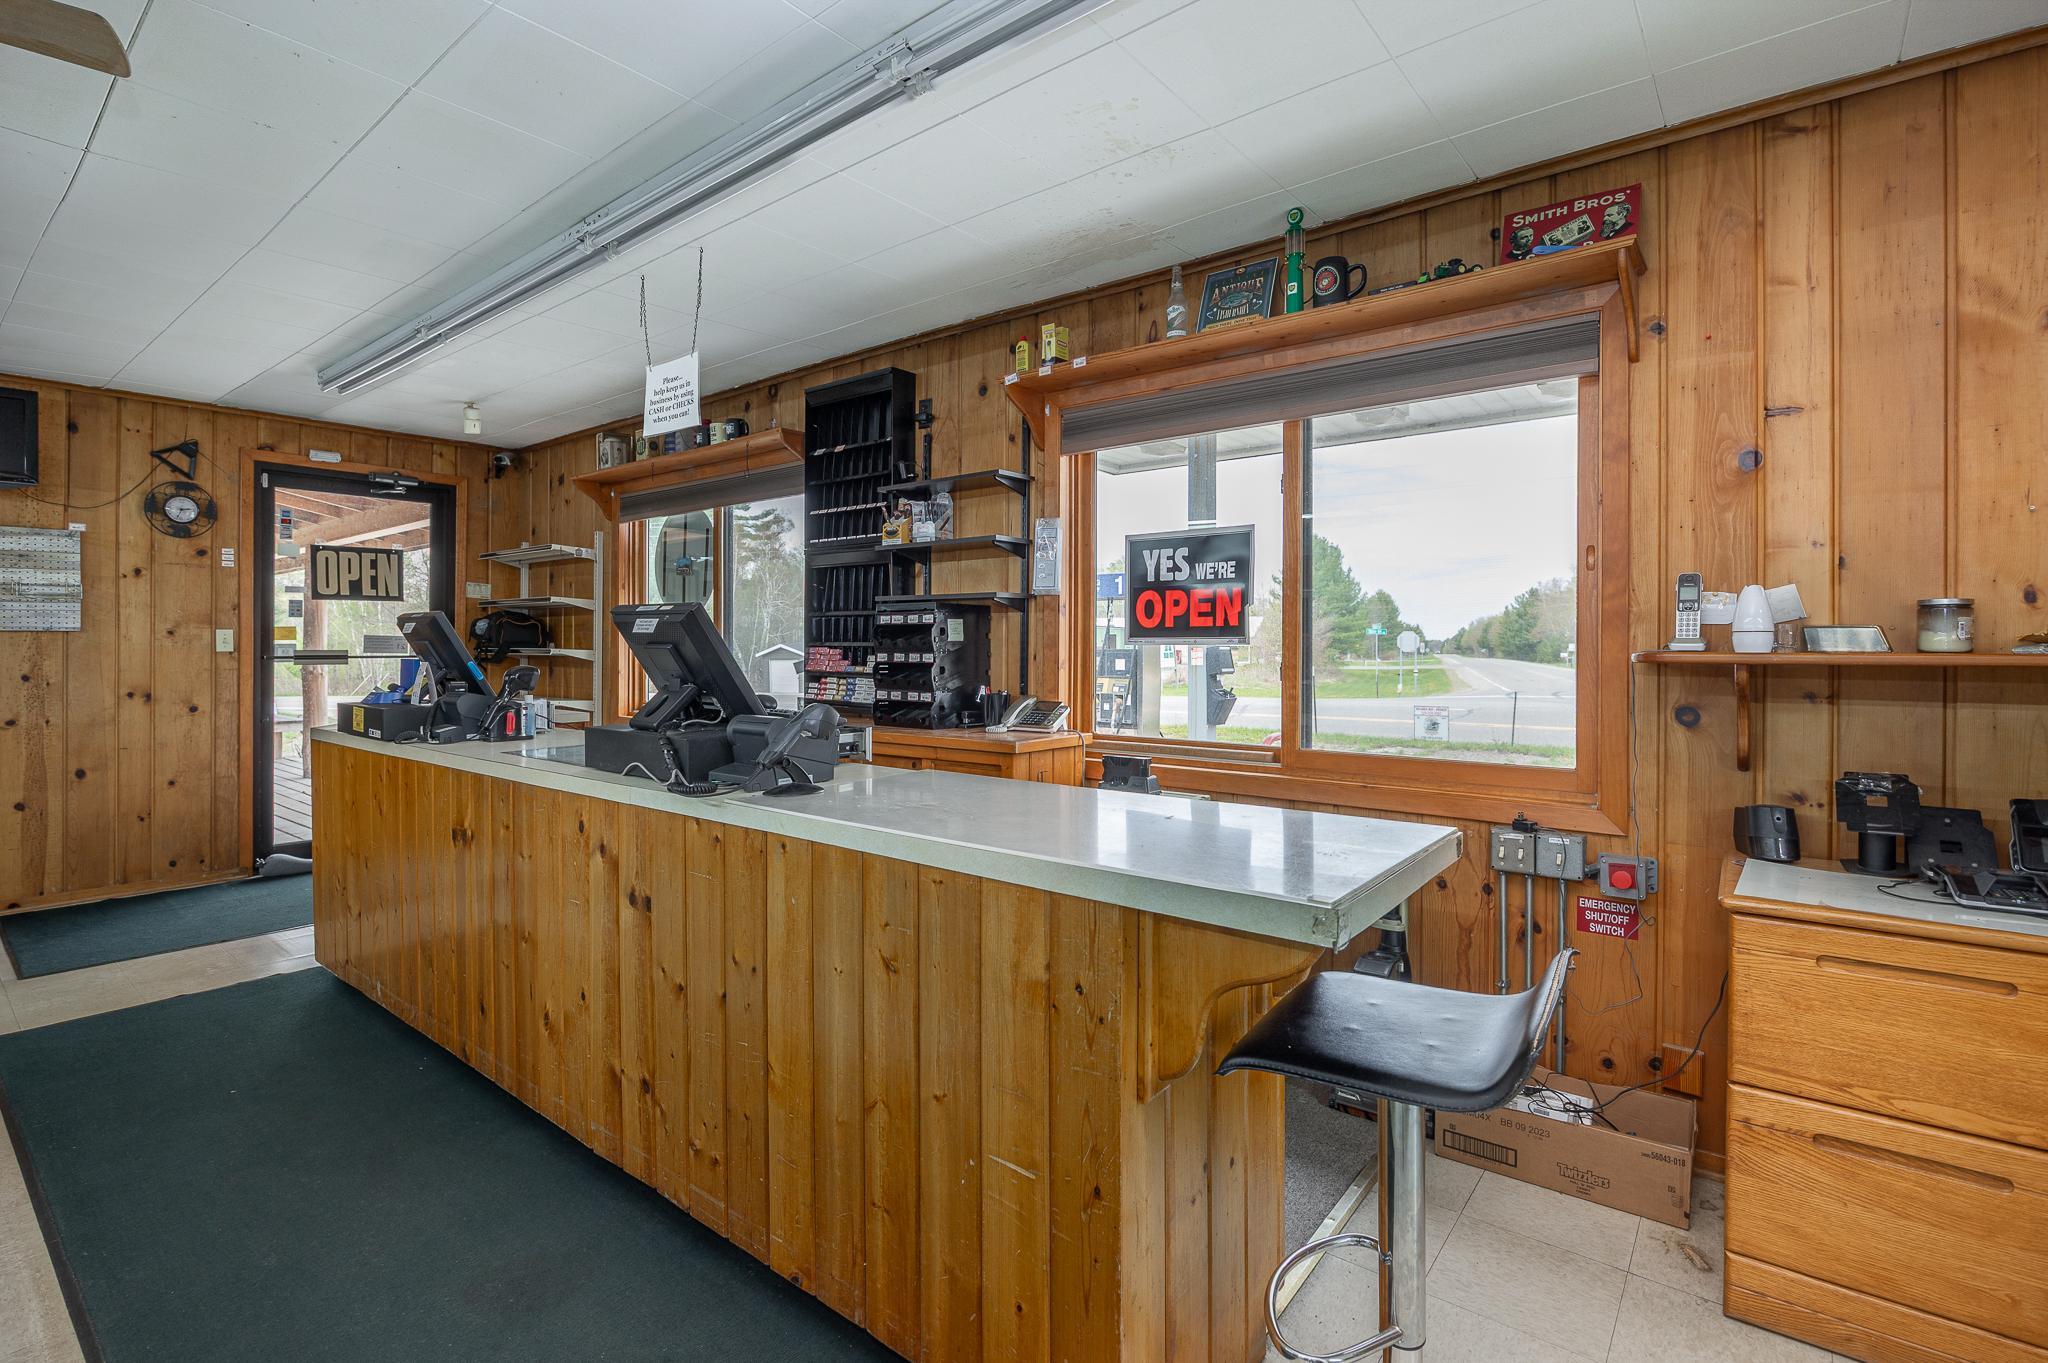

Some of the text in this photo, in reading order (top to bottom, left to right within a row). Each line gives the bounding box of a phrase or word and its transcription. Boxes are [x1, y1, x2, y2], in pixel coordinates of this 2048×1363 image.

[1512, 206, 1568, 228] SMITH
[1211, 277, 1264, 305] ANTIQUE
[653, 387, 665, 396] help
[666, 384, 678, 394] keep
[685, 380, 691, 388] in
[648, 406, 664, 416] CASH
[672, 398, 695, 410] CHECKS
[649, 389, 694, 407] business by using
[652, 408, 690, 424] when you can!
[316, 550, 399, 597] OPEN
[1142, 547, 1236, 582] YES WE'RE
[1135, 587, 1242, 629] OPEN
[1579, 897, 1636, 914] EMERGENCY
[1585, 911, 1630, 926] SHUT/OFF
[1589, 922, 1625, 937] SWITCH
[1500, 1118, 1551, 1138] BB 09 2023
[1557, 1162, 1611, 1189] Twizzlers
